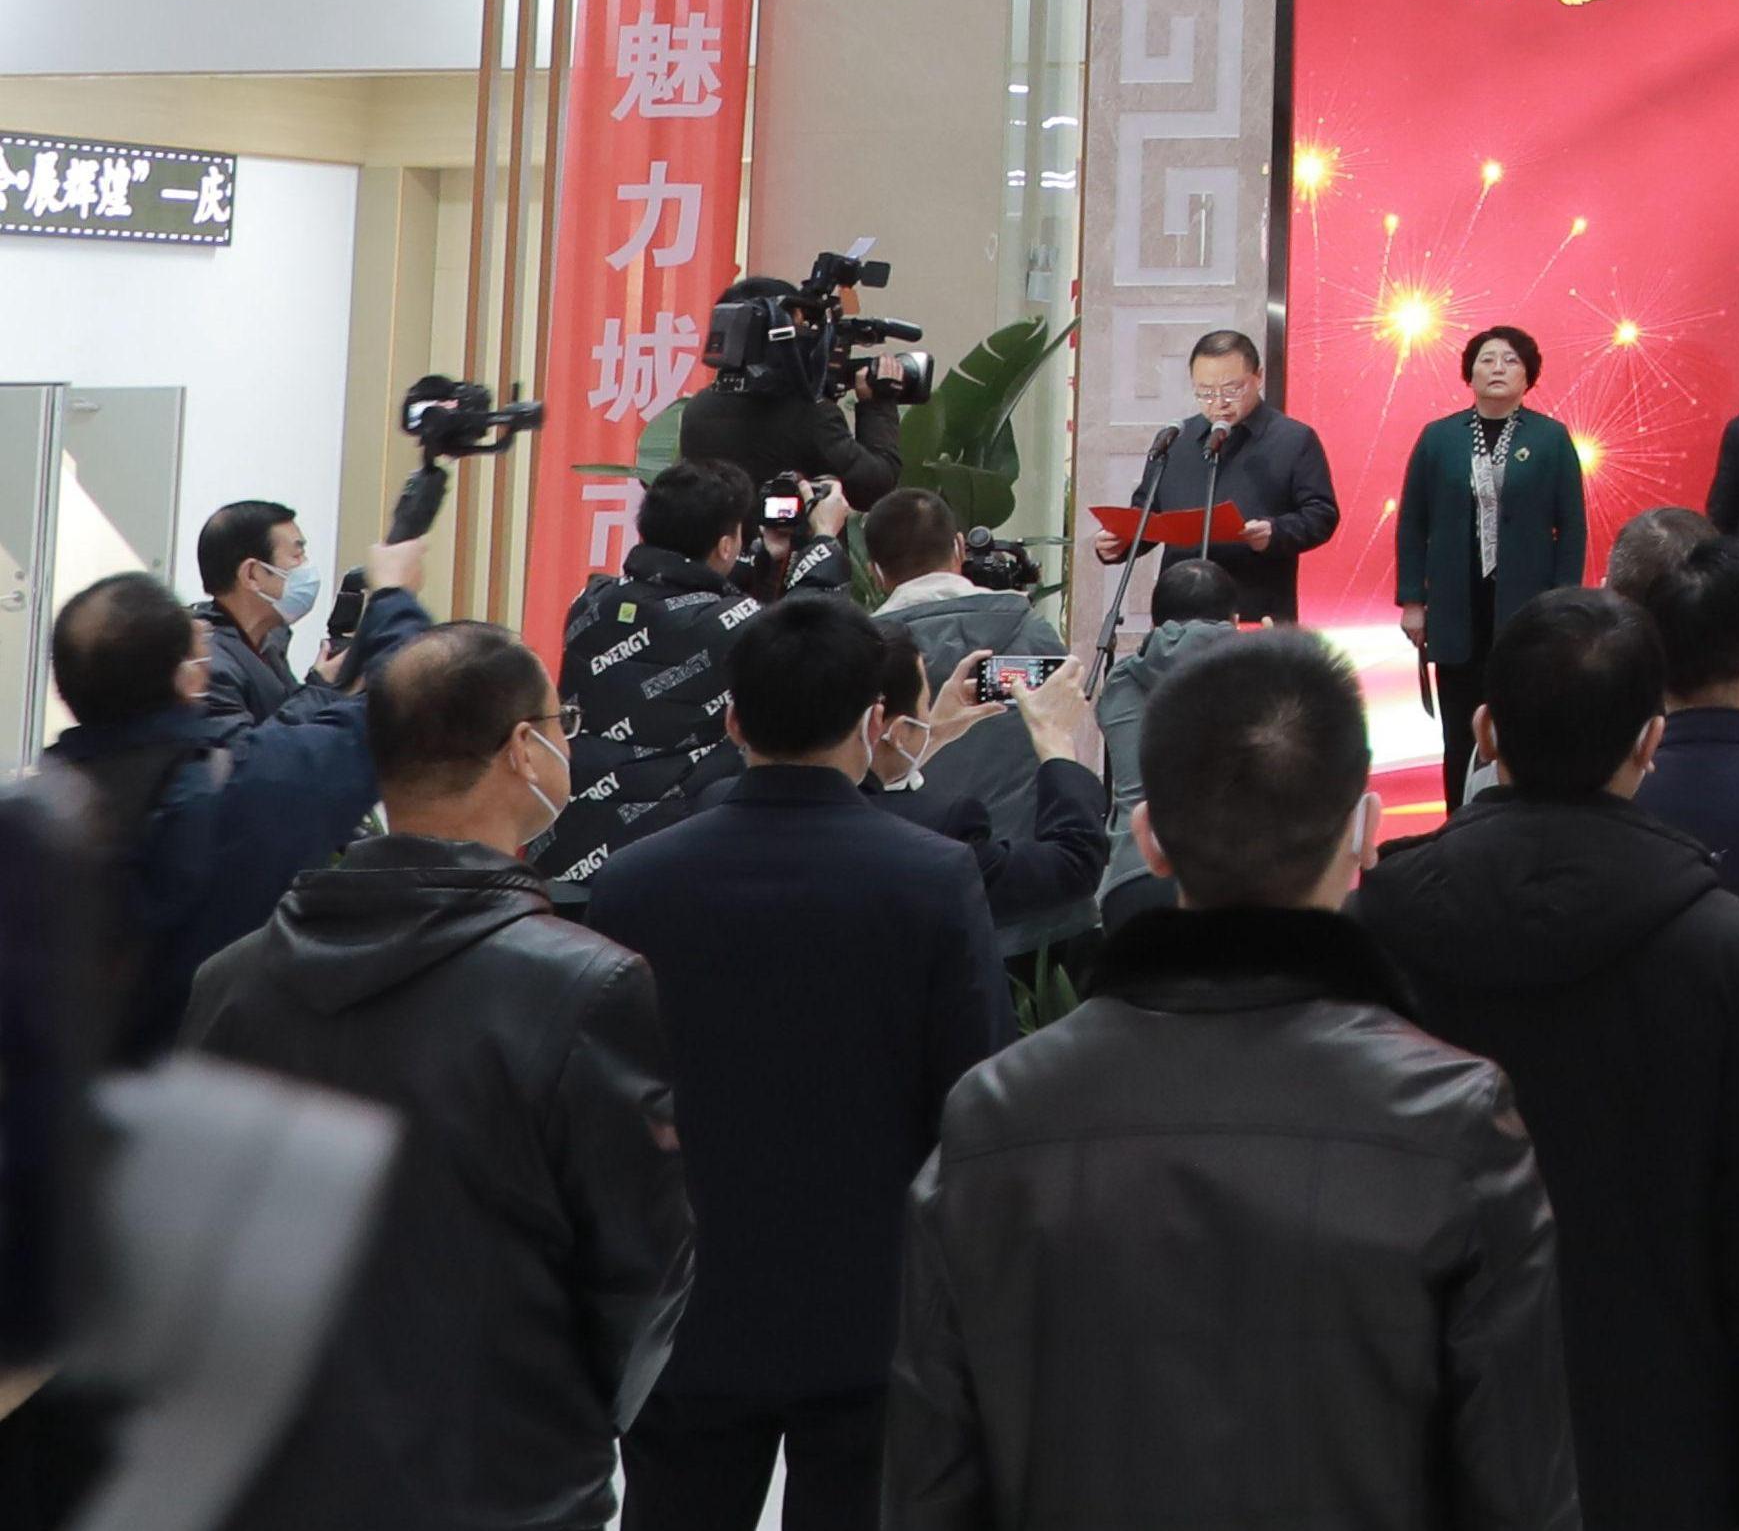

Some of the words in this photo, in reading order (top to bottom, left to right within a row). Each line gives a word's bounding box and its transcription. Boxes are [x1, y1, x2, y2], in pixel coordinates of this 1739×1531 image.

[718, 597, 761, 631] ENER
[590, 627, 651, 675] ENERGY
[640, 649, 712, 700] ENERGY
